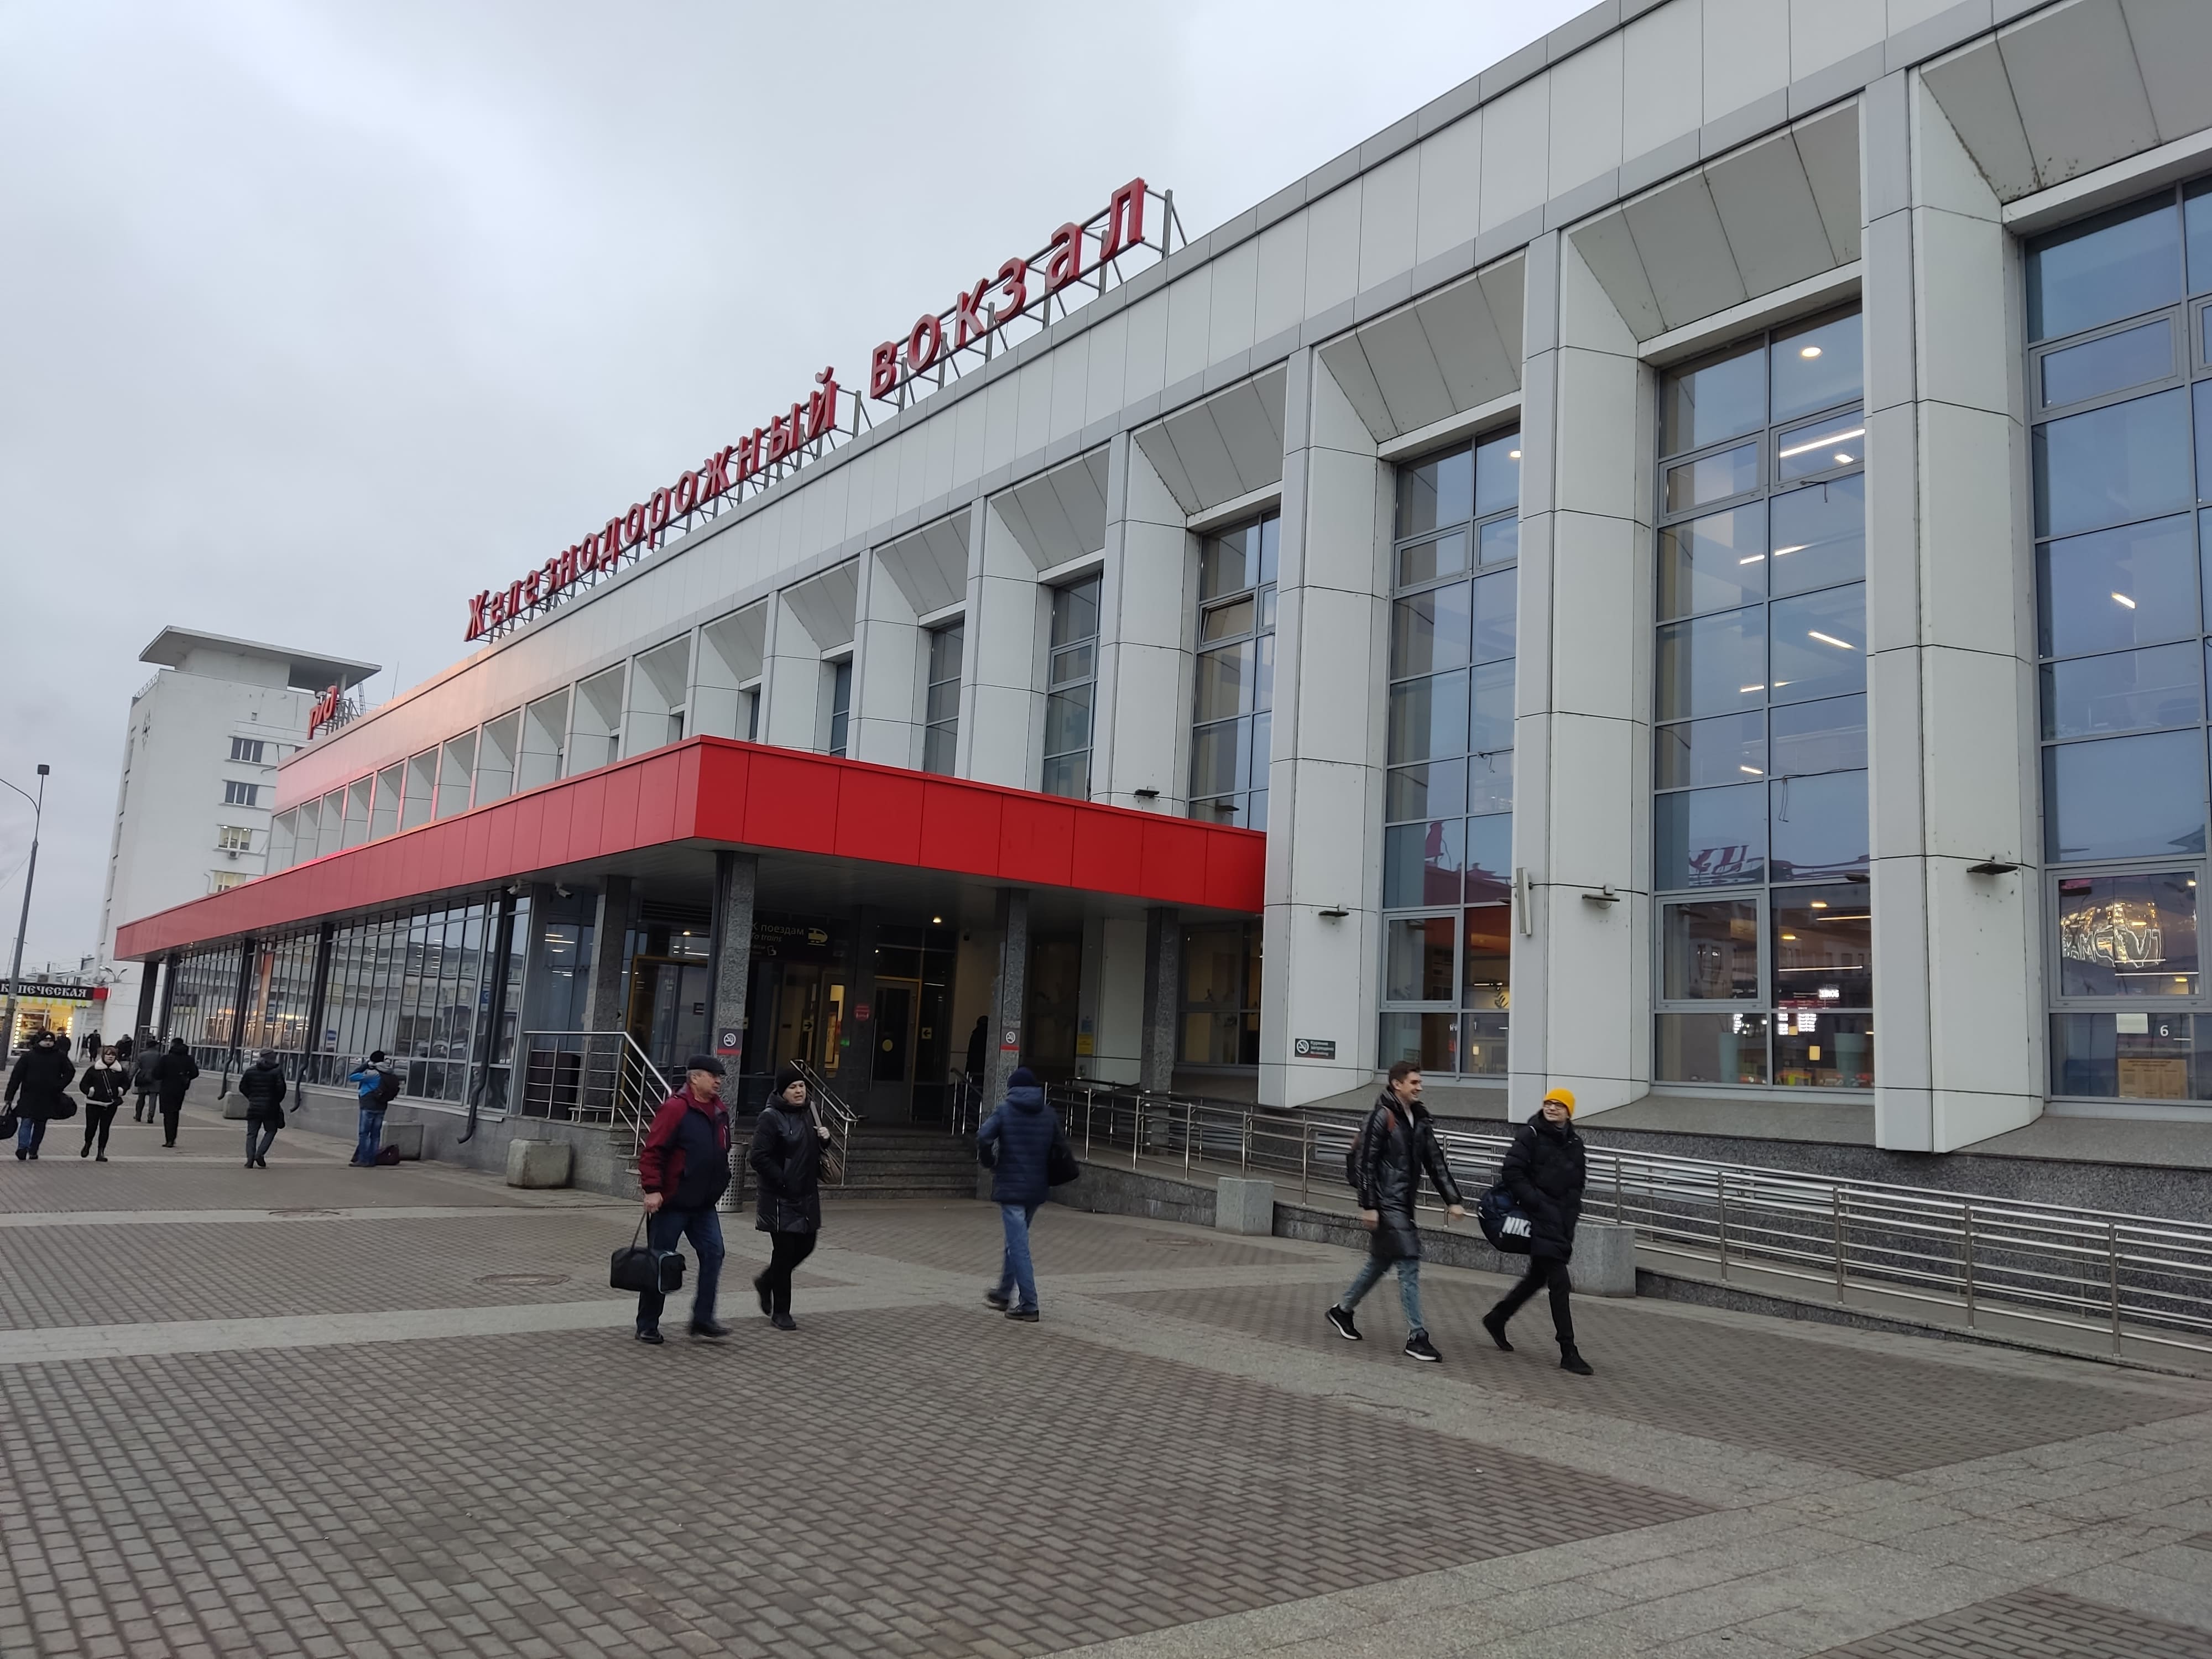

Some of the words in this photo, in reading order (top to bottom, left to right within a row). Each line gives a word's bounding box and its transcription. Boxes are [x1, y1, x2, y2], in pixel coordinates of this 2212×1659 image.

[464, 366, 837, 641] Железнодорожный
[870, 177, 1145, 399] вокзал
[761, 924, 804, 936] поездам
[761, 933, 782, 942] trains
[1, 983, 87, 998] КПЕЧЕСКАЯ
[2160, 1025, 2169, 1037] 6
